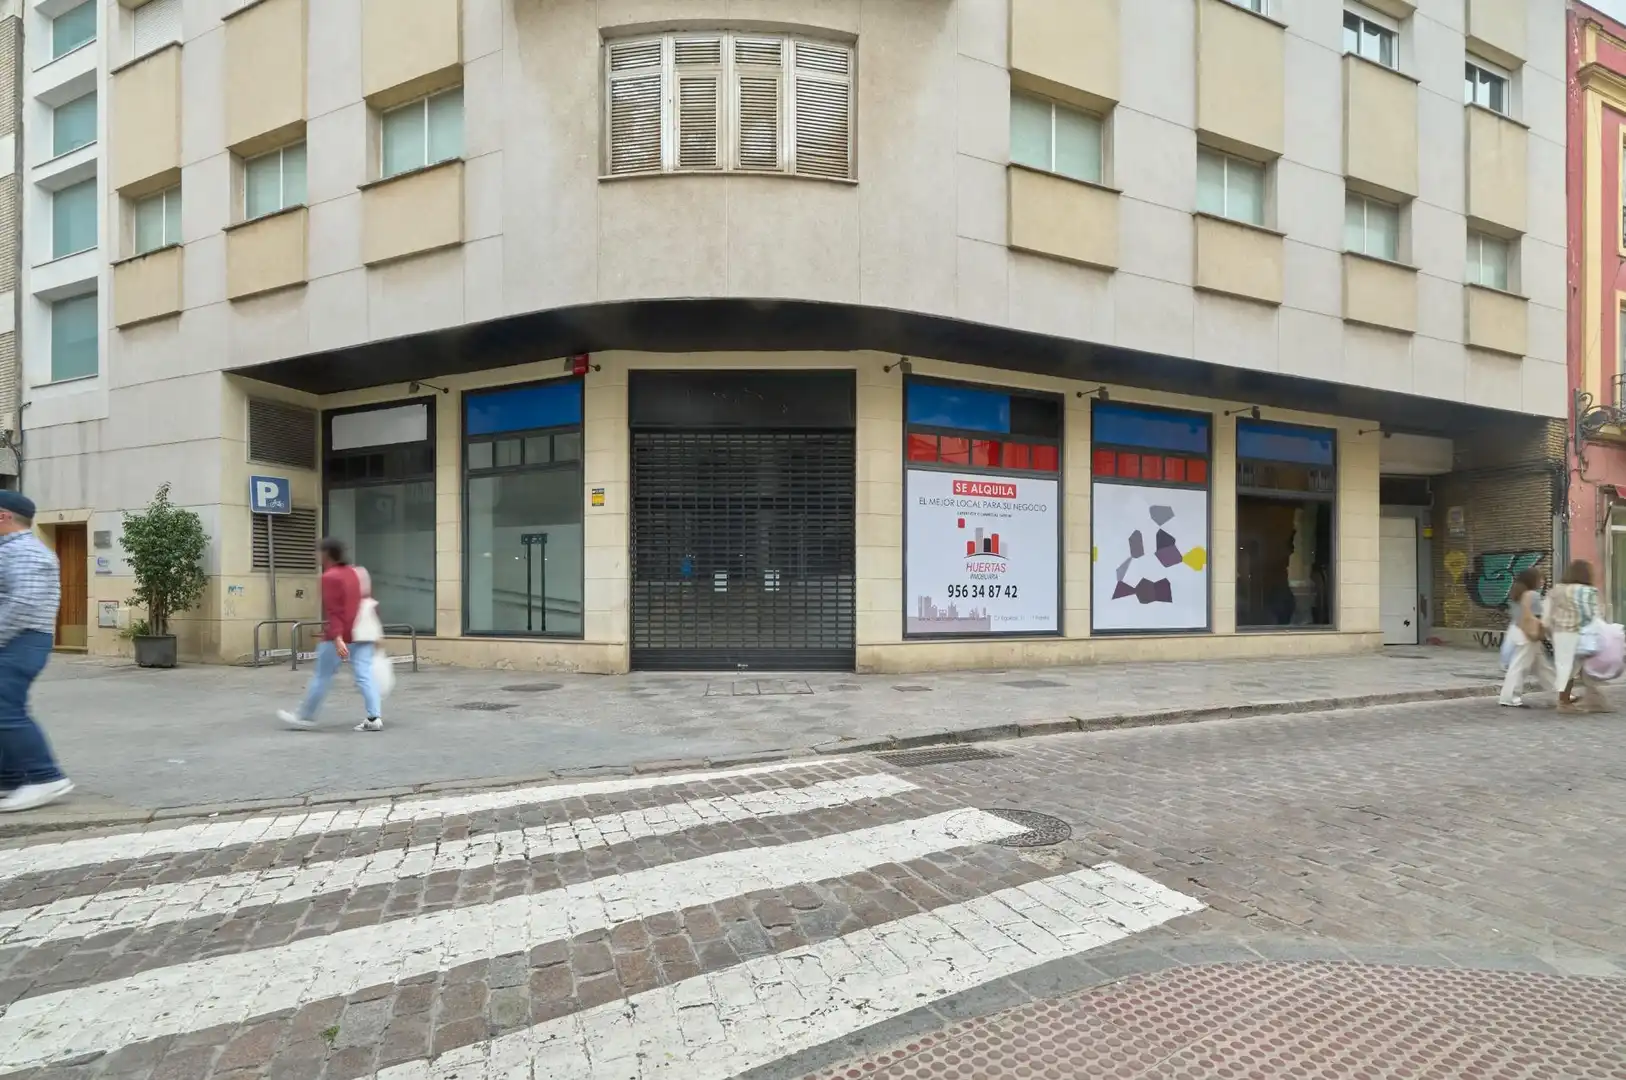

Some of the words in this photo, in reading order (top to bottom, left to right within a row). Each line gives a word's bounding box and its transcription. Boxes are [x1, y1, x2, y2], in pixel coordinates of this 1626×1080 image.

[257, 481, 279, 507] P
[955, 482, 968, 493] SE
[971, 483, 1014, 496] ALQUILA
[919, 497, 927, 505] EL
[929, 498, 955, 507] MEJOR
[957, 500, 980, 509] LOCAL
[983, 501, 1001, 509] PARA
[1003, 502, 1011, 510] SU
[1013, 503, 1047, 512] NEGOCIO
[966, 562, 1006, 573] HUERTAS
[948, 584, 968, 598] 956
[971, 584, 985, 598] 34
[988, 584, 1001, 598] 87
[1004, 585, 1018, 598] 42
